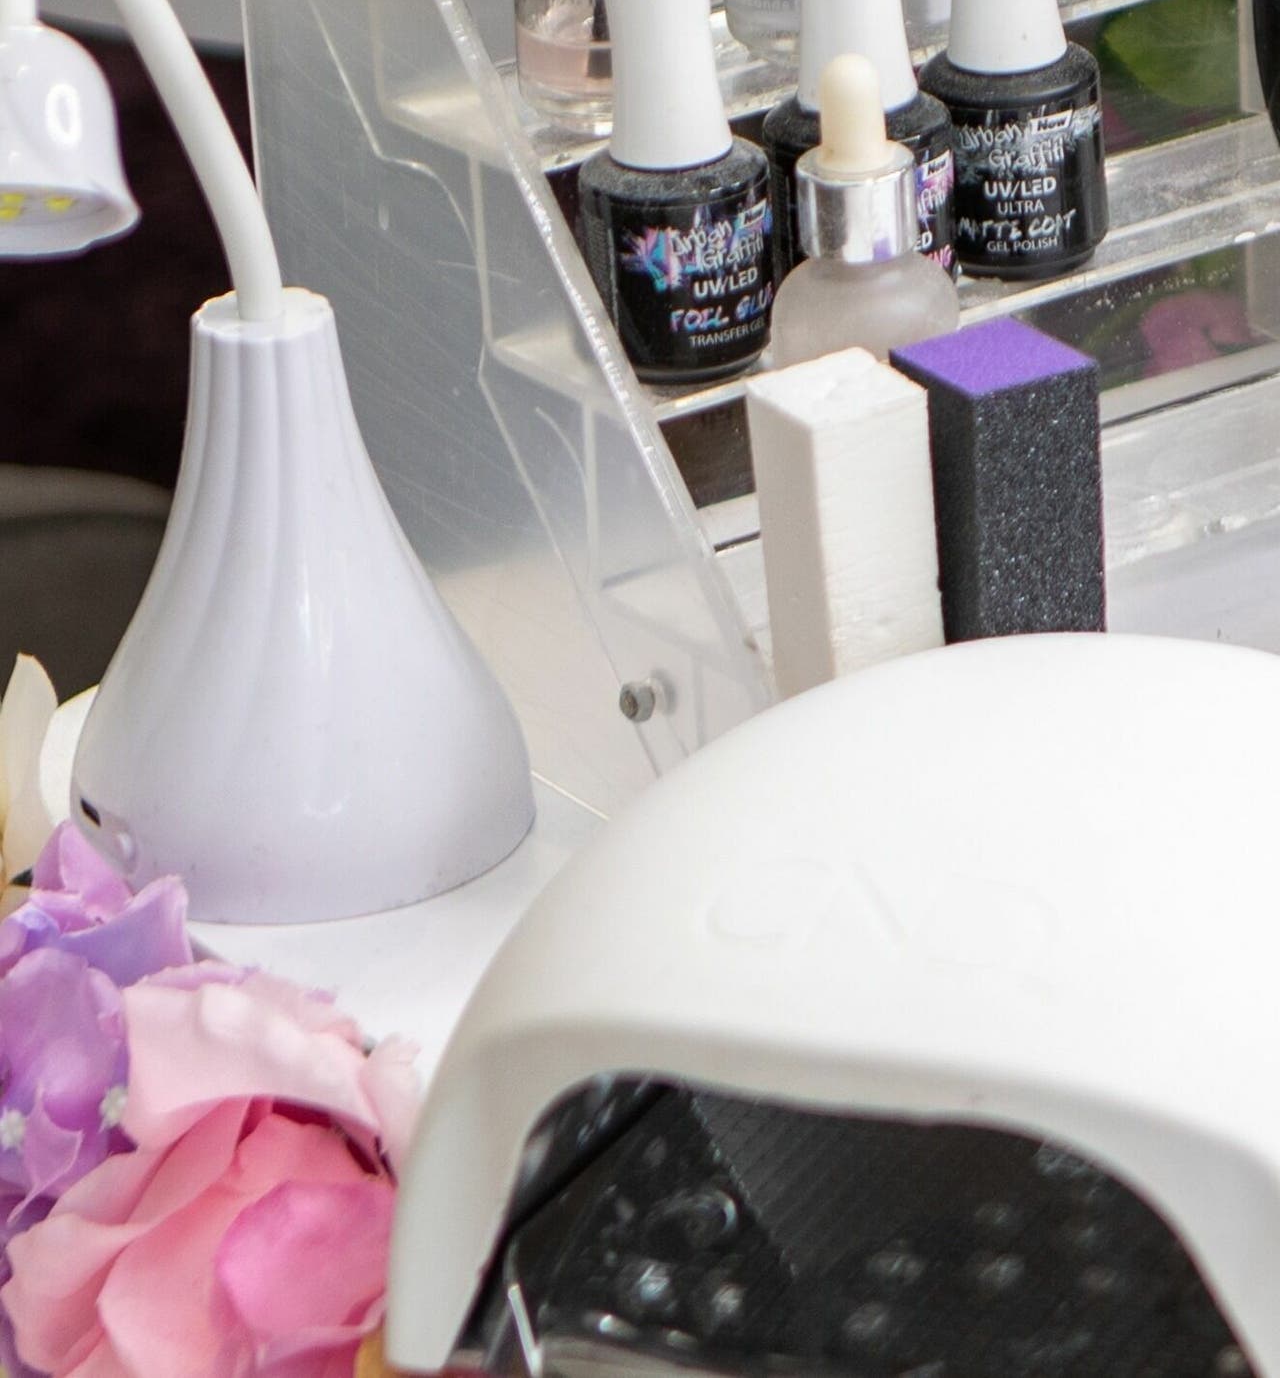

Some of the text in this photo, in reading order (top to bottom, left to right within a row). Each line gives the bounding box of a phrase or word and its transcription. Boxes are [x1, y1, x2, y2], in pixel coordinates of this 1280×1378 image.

[959, 118, 1067, 151] Urban New
[988, 136, 1066, 170] Graffiti
[984, 176, 1057, 198] UV/LED
[997, 198, 1045, 216] ULTRA
[1028, 208, 1077, 236] COAT
[670, 219, 732, 258] Urban
[702, 229, 765, 271] Graffiti
[987, 236, 1058, 253] GEL POLISH
[693, 267, 758, 299] UV/LED
[670, 305, 730, 332] FOIL
[689, 326, 750, 347] TRANSFER
